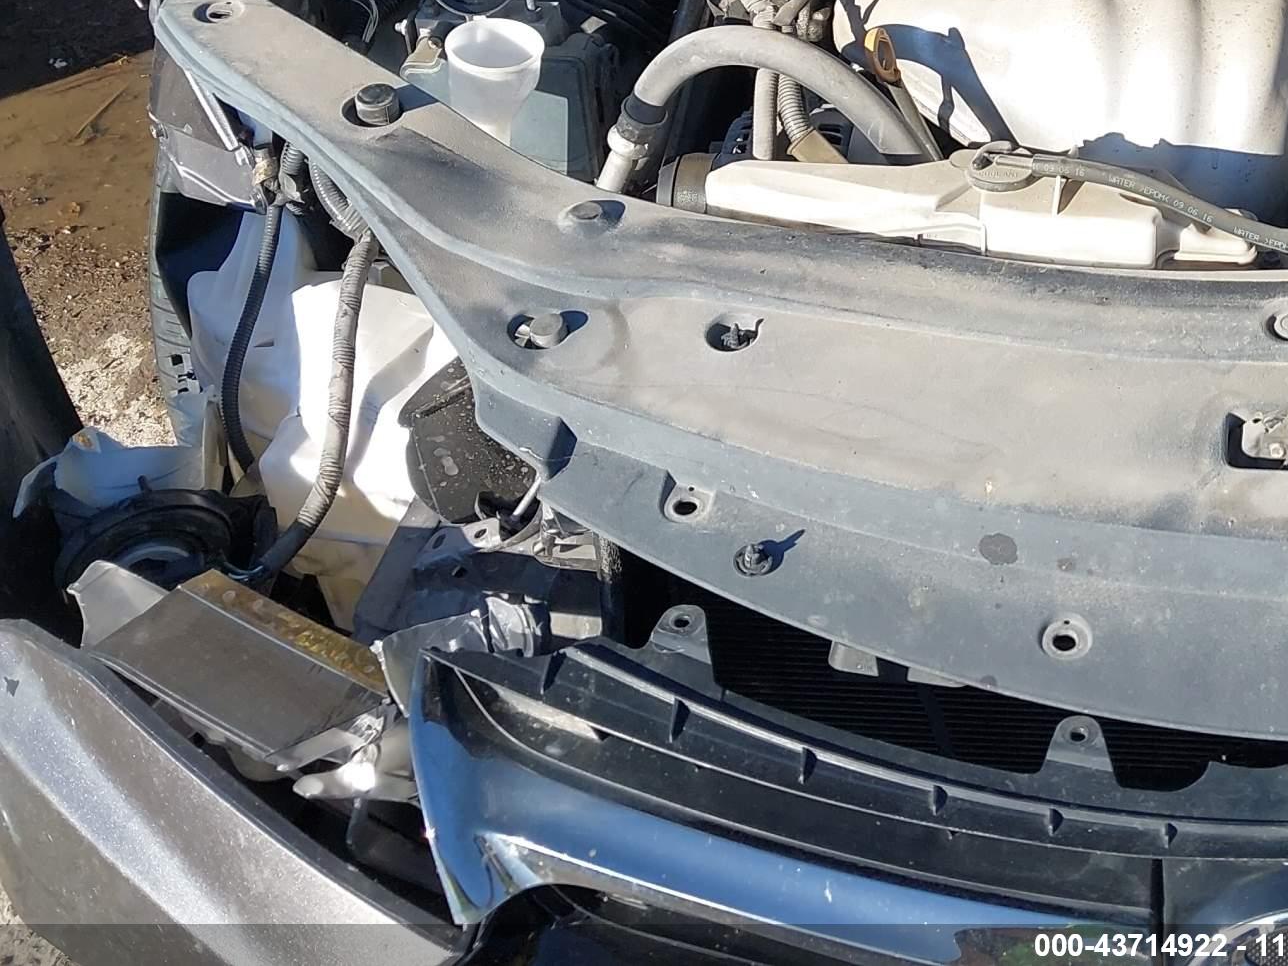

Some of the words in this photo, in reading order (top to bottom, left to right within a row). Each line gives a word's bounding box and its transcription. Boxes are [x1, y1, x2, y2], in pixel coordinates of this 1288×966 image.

[1108, 174, 1136, 188] WATER
[1172, 199, 1184, 209] 09
[1202, 213, 1214, 223] 16
[1233, 225, 1260, 242] WATER
